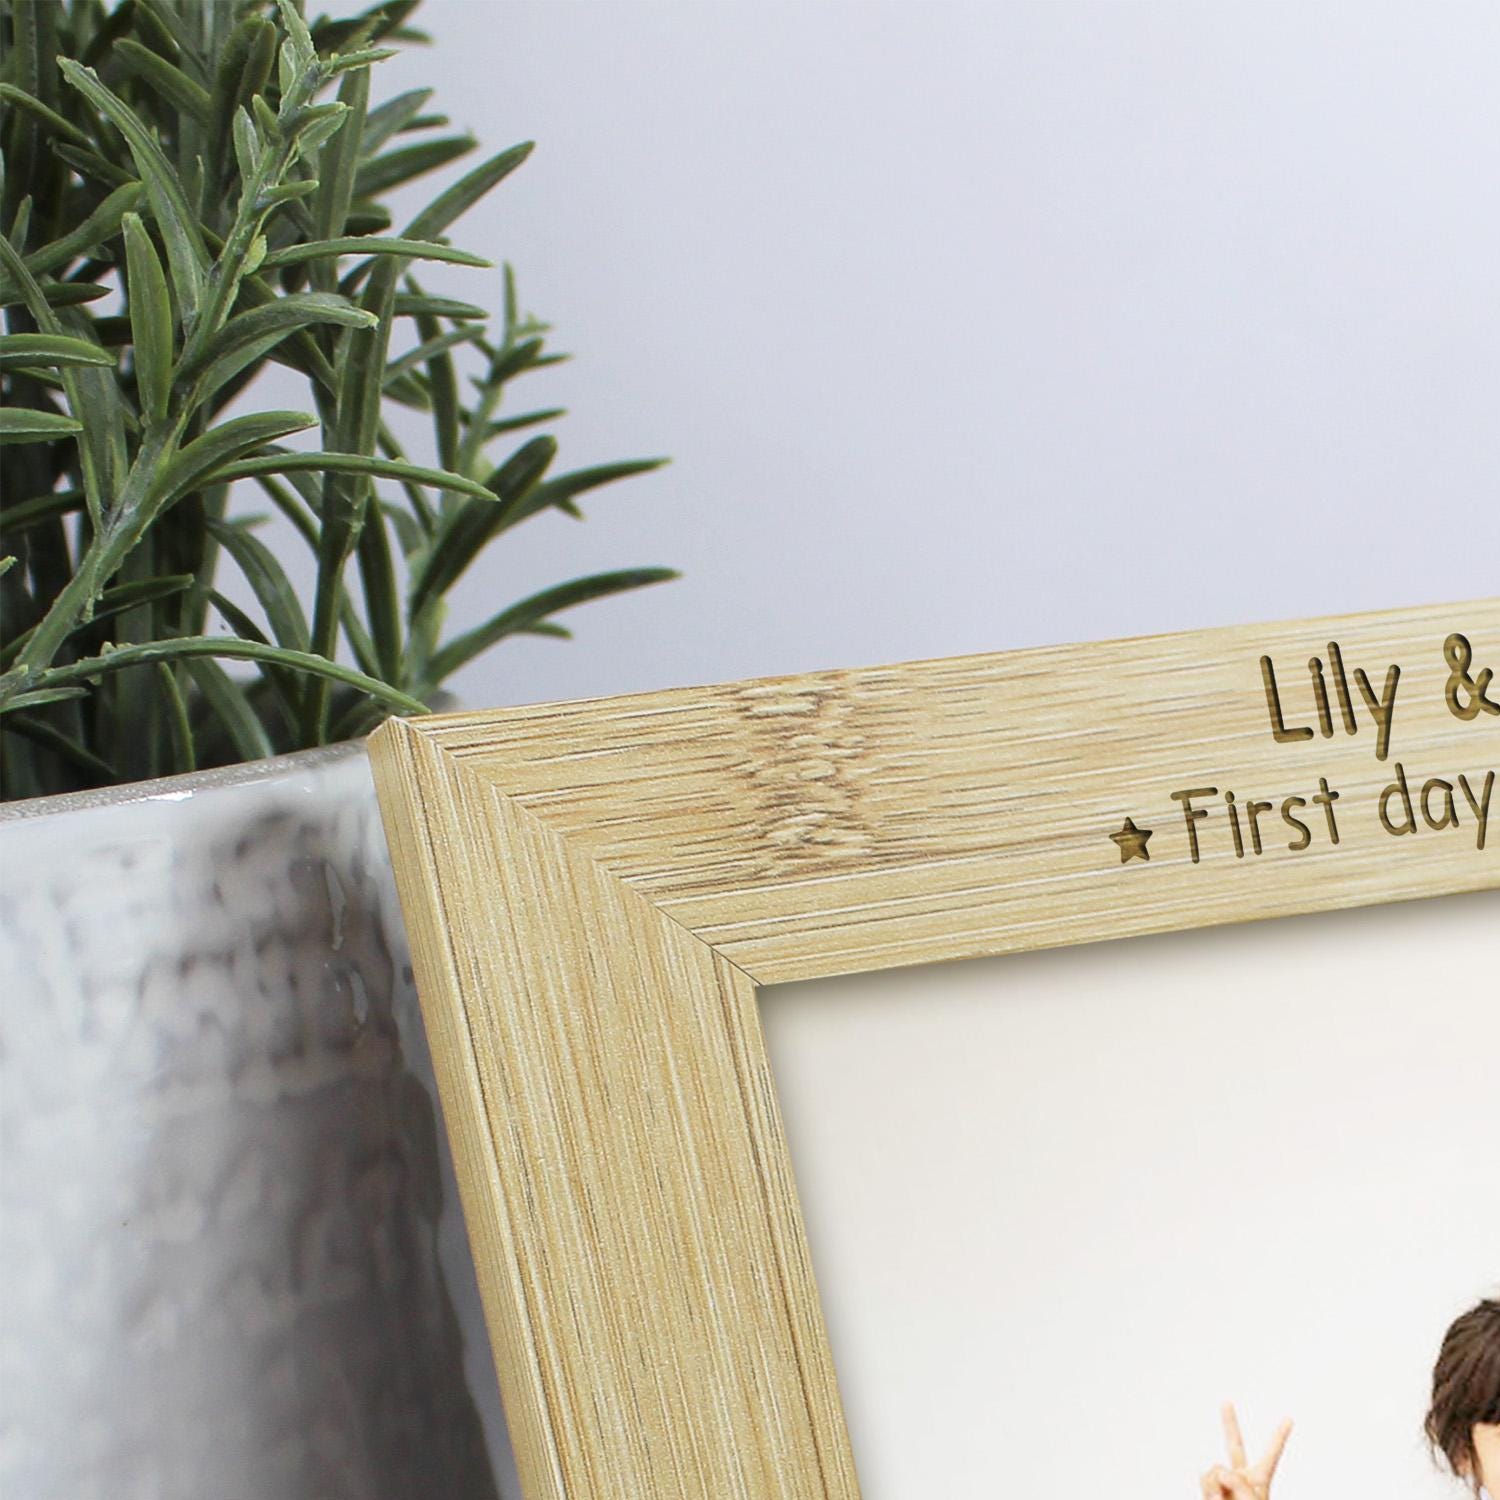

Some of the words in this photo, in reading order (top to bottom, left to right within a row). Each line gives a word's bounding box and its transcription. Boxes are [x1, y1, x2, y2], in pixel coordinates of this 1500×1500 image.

[1260, 641, 1401, 760] Lily
[1171, 777, 1339, 864] First
[1380, 763, 1495, 850] day
